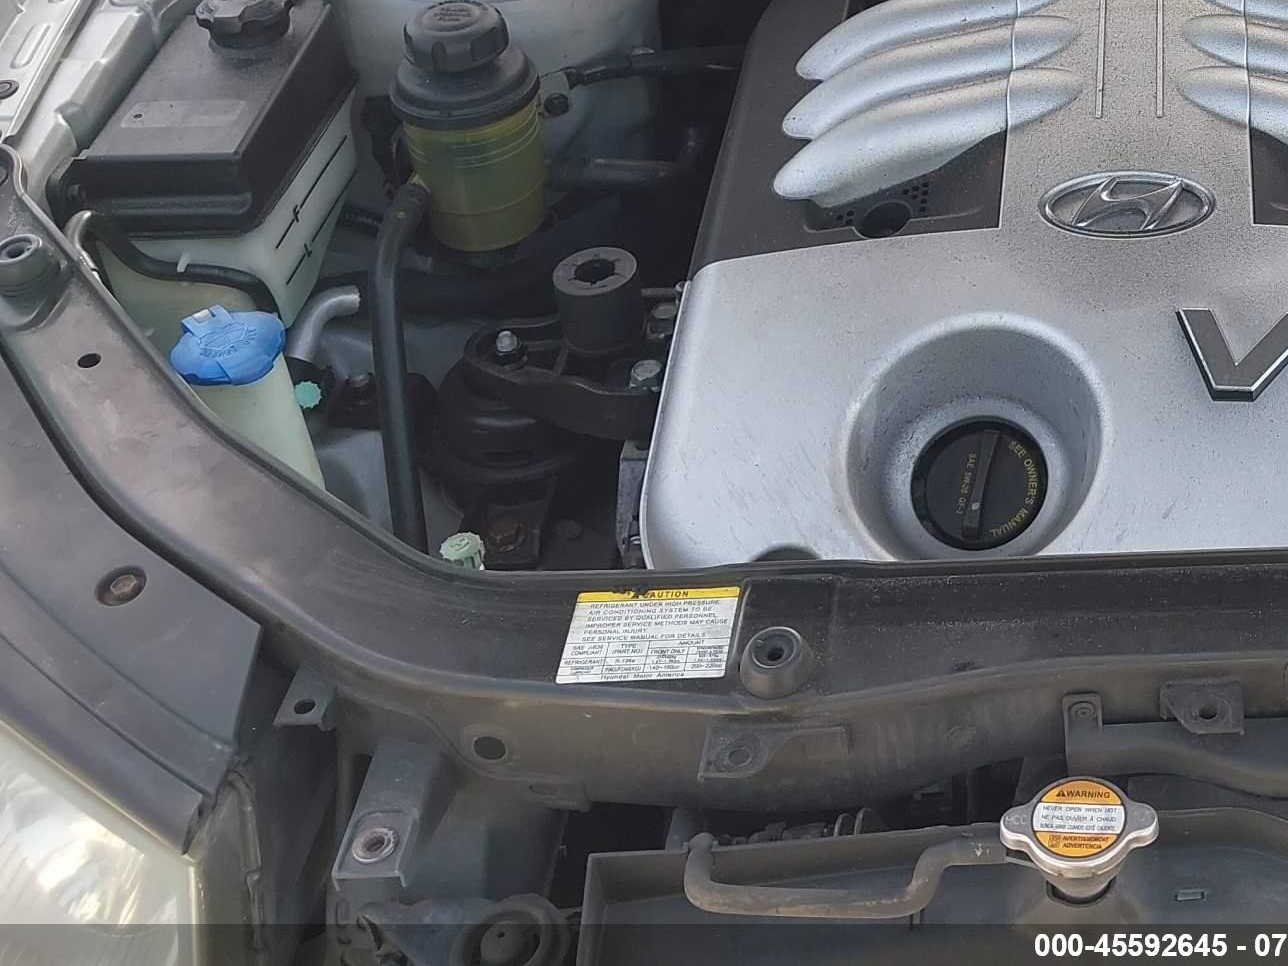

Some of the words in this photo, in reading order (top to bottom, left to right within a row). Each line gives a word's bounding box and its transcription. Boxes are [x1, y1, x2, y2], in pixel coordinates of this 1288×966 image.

[1008, 442, 1026, 458] SEE
[1023, 458, 1038, 505] OWNER'S
[1066, 790, 1110, 799] WARNING
